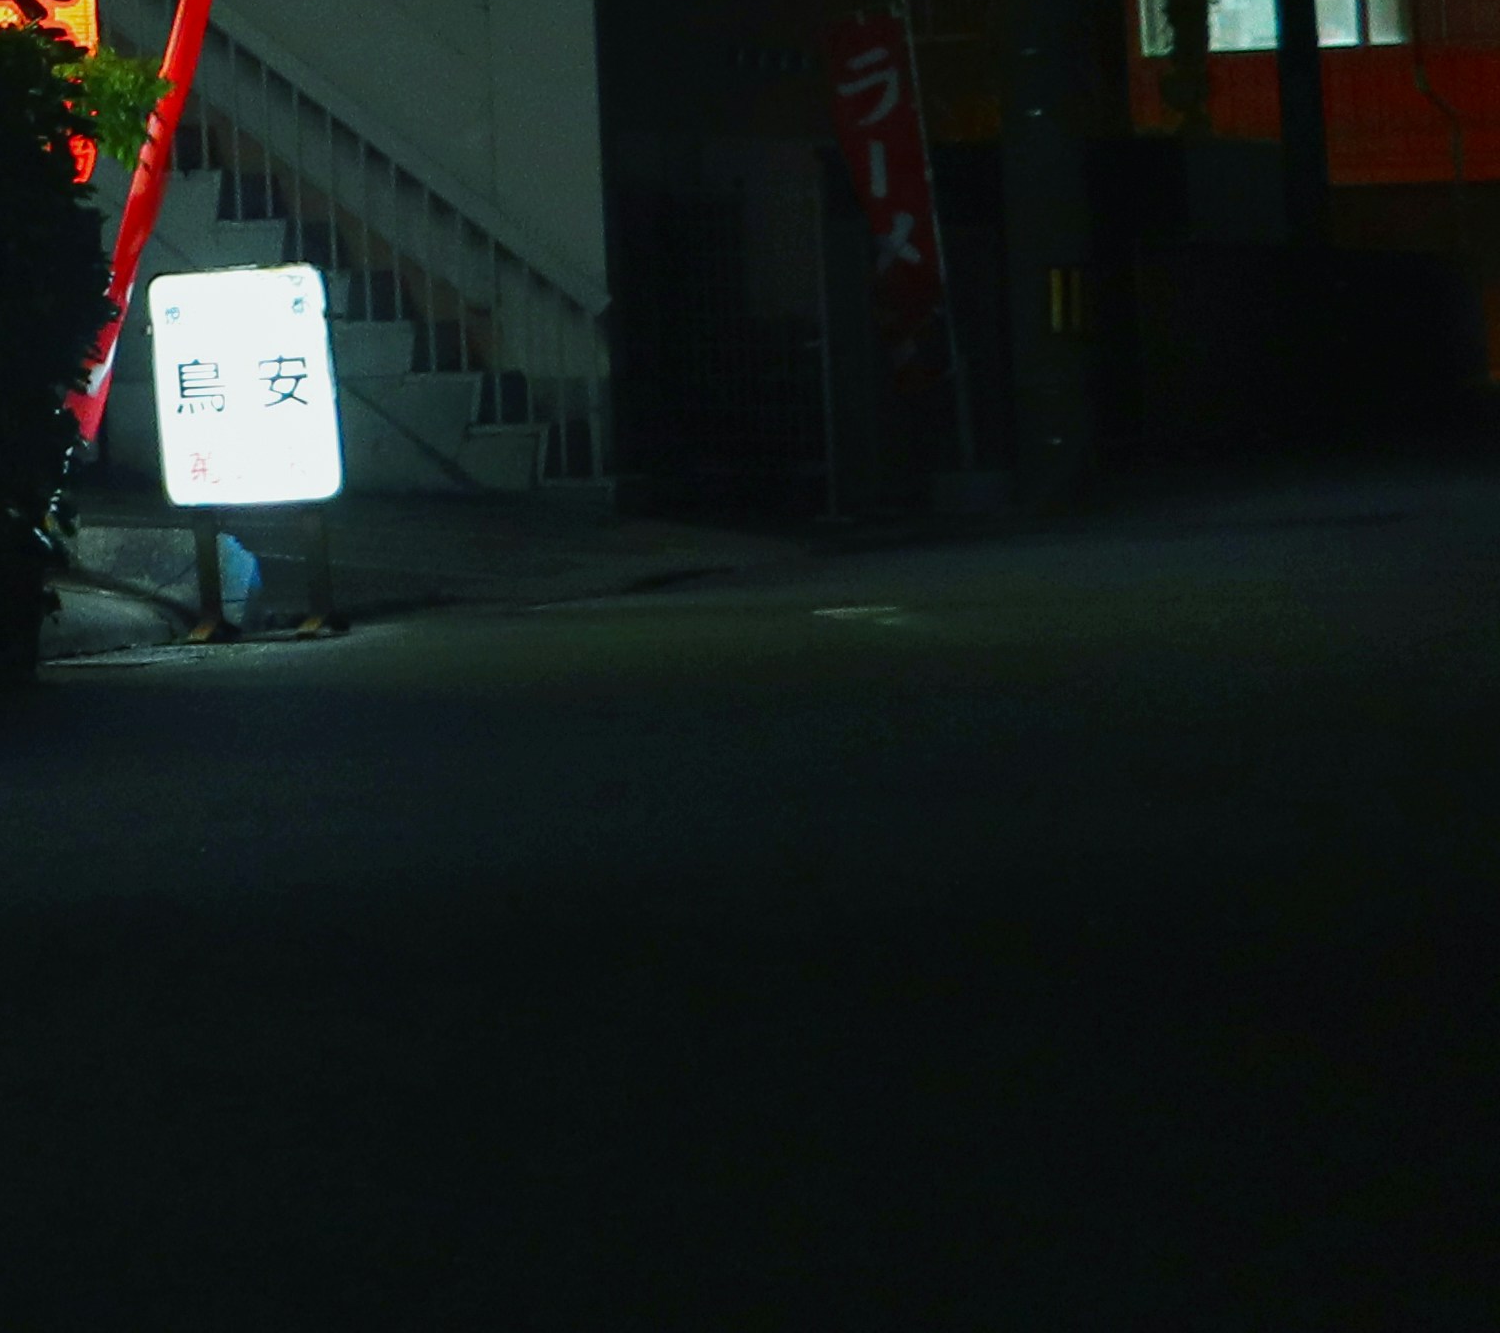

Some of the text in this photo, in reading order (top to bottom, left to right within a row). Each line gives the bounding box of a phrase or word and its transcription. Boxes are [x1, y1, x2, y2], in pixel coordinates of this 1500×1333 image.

[836, 45, 922, 367] ラーメ
[176, 354, 309, 415] 鳥安
